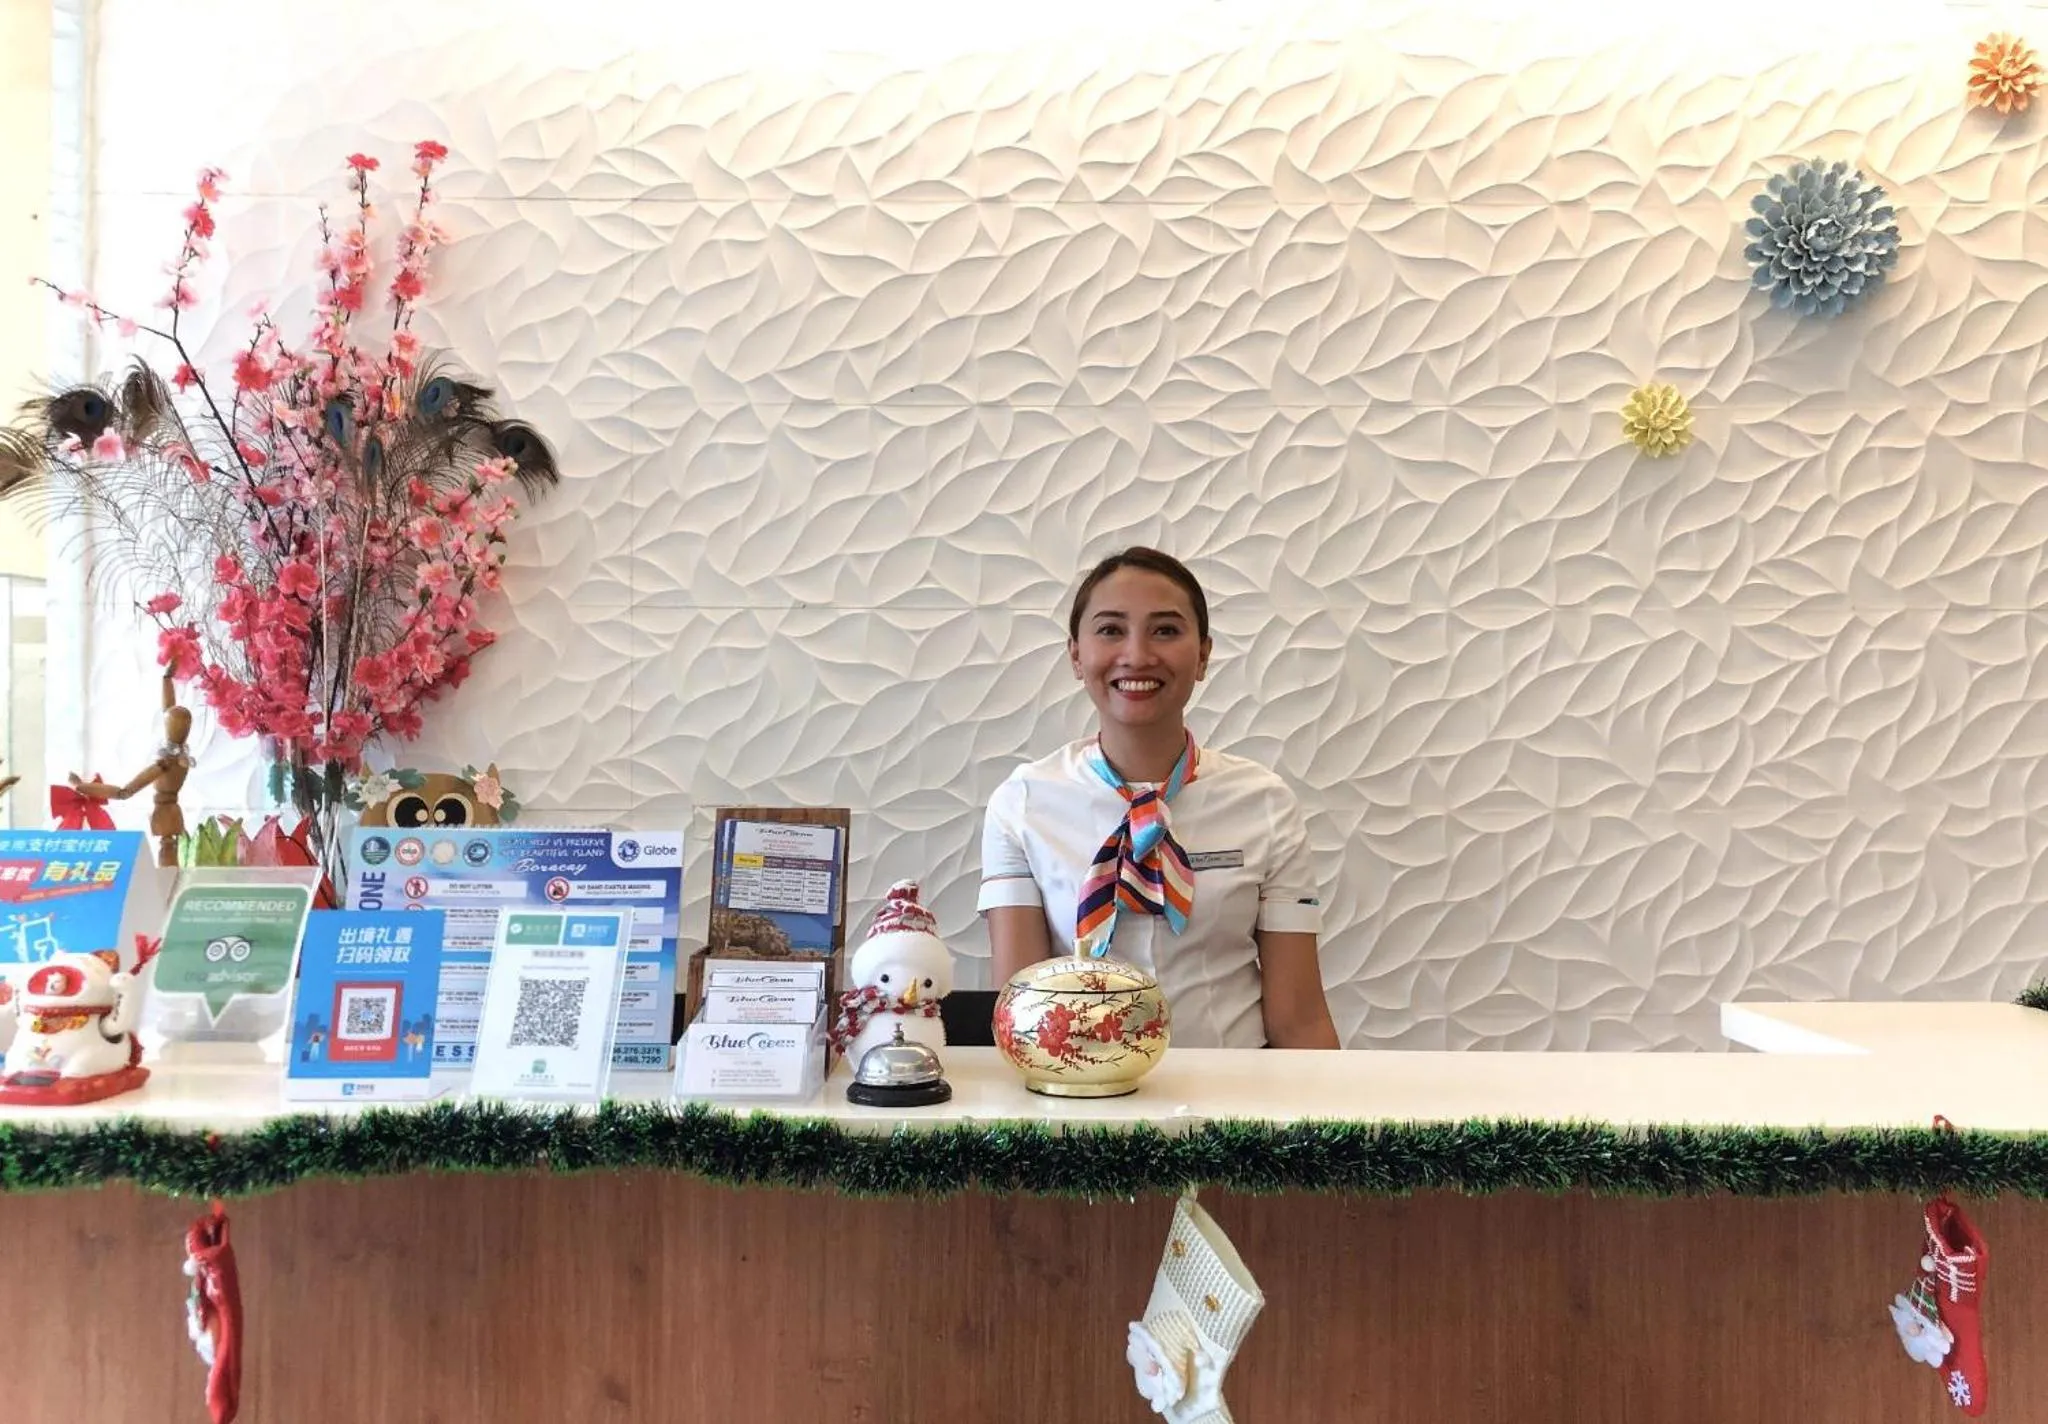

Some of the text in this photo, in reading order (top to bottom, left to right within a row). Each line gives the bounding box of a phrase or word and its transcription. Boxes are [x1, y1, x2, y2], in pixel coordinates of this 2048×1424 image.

[565, 837, 606, 847] PRESERVE
[520, 848, 569, 858] BEAUTIFUL
[572, 848, 606, 858] ISLAND
[643, 845, 677, 856] Globe
[43, 859, 122, 882] 有礼品
[512, 857, 587, 875] Boracay
[182, 900, 297, 912] RECOMMENDED
[338, 926, 413, 944] 出境礼遇
[336, 945, 412, 964] 扫码领取
